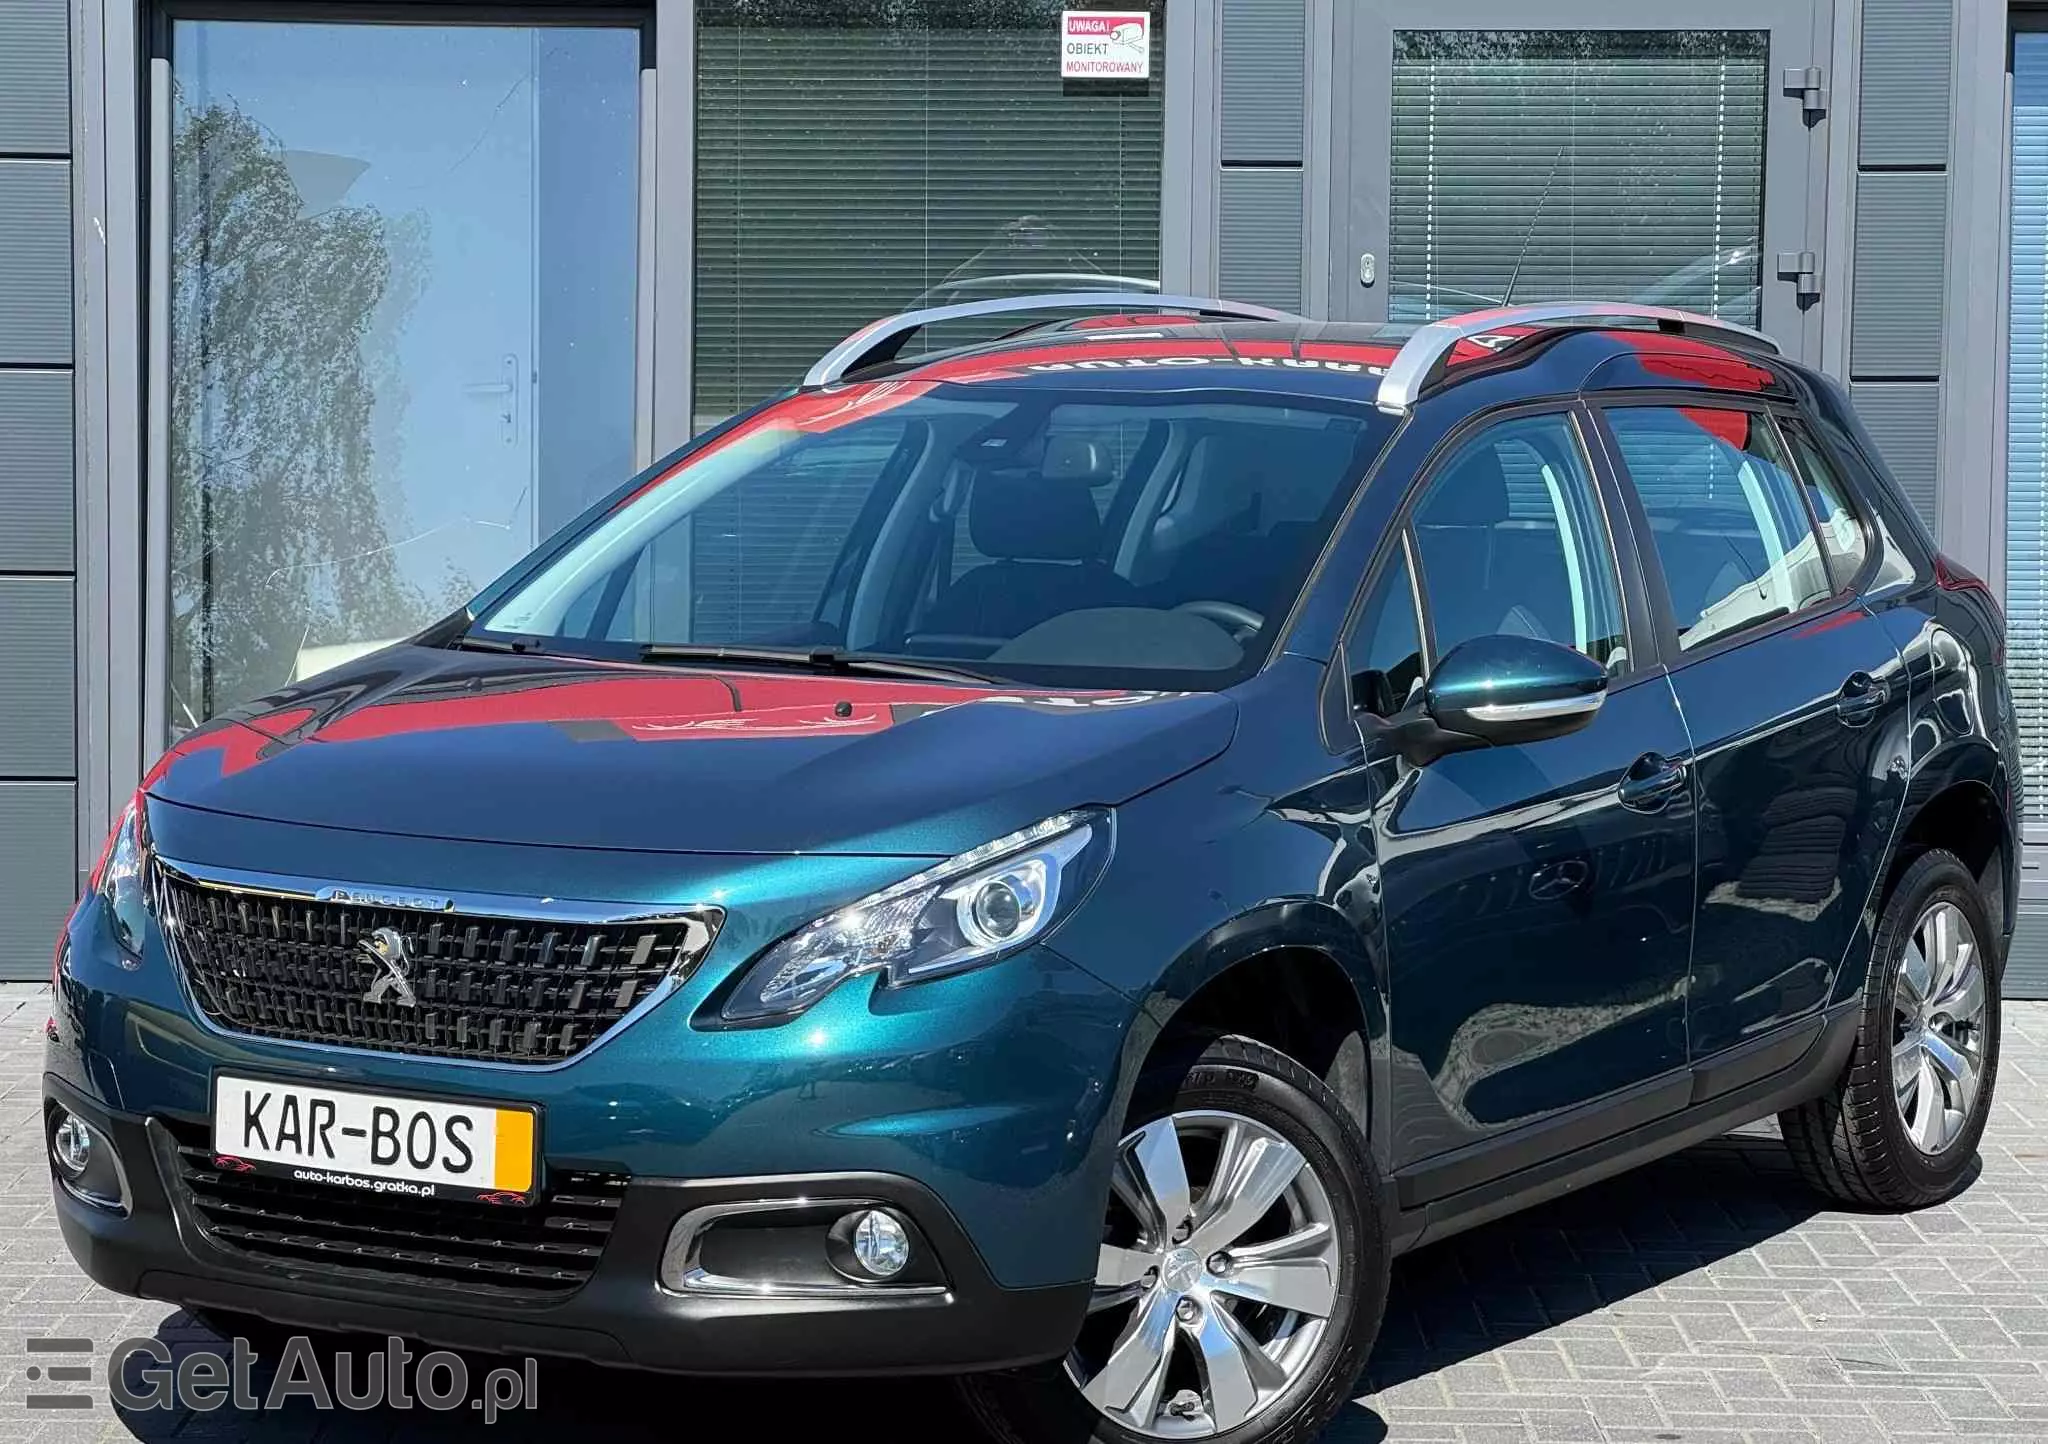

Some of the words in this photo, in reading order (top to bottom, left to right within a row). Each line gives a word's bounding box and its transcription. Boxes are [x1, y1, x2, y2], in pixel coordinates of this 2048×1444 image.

[1068, 20, 1111, 33] UWAGA!
[1066, 43, 1108, 55] OBIEKT
[1066, 61, 1143, 73] MONITOROWANY
[244, 1090, 474, 1174] KAR-BOS
[293, 1169, 436, 1198] auto-karbos.gratka.pl
